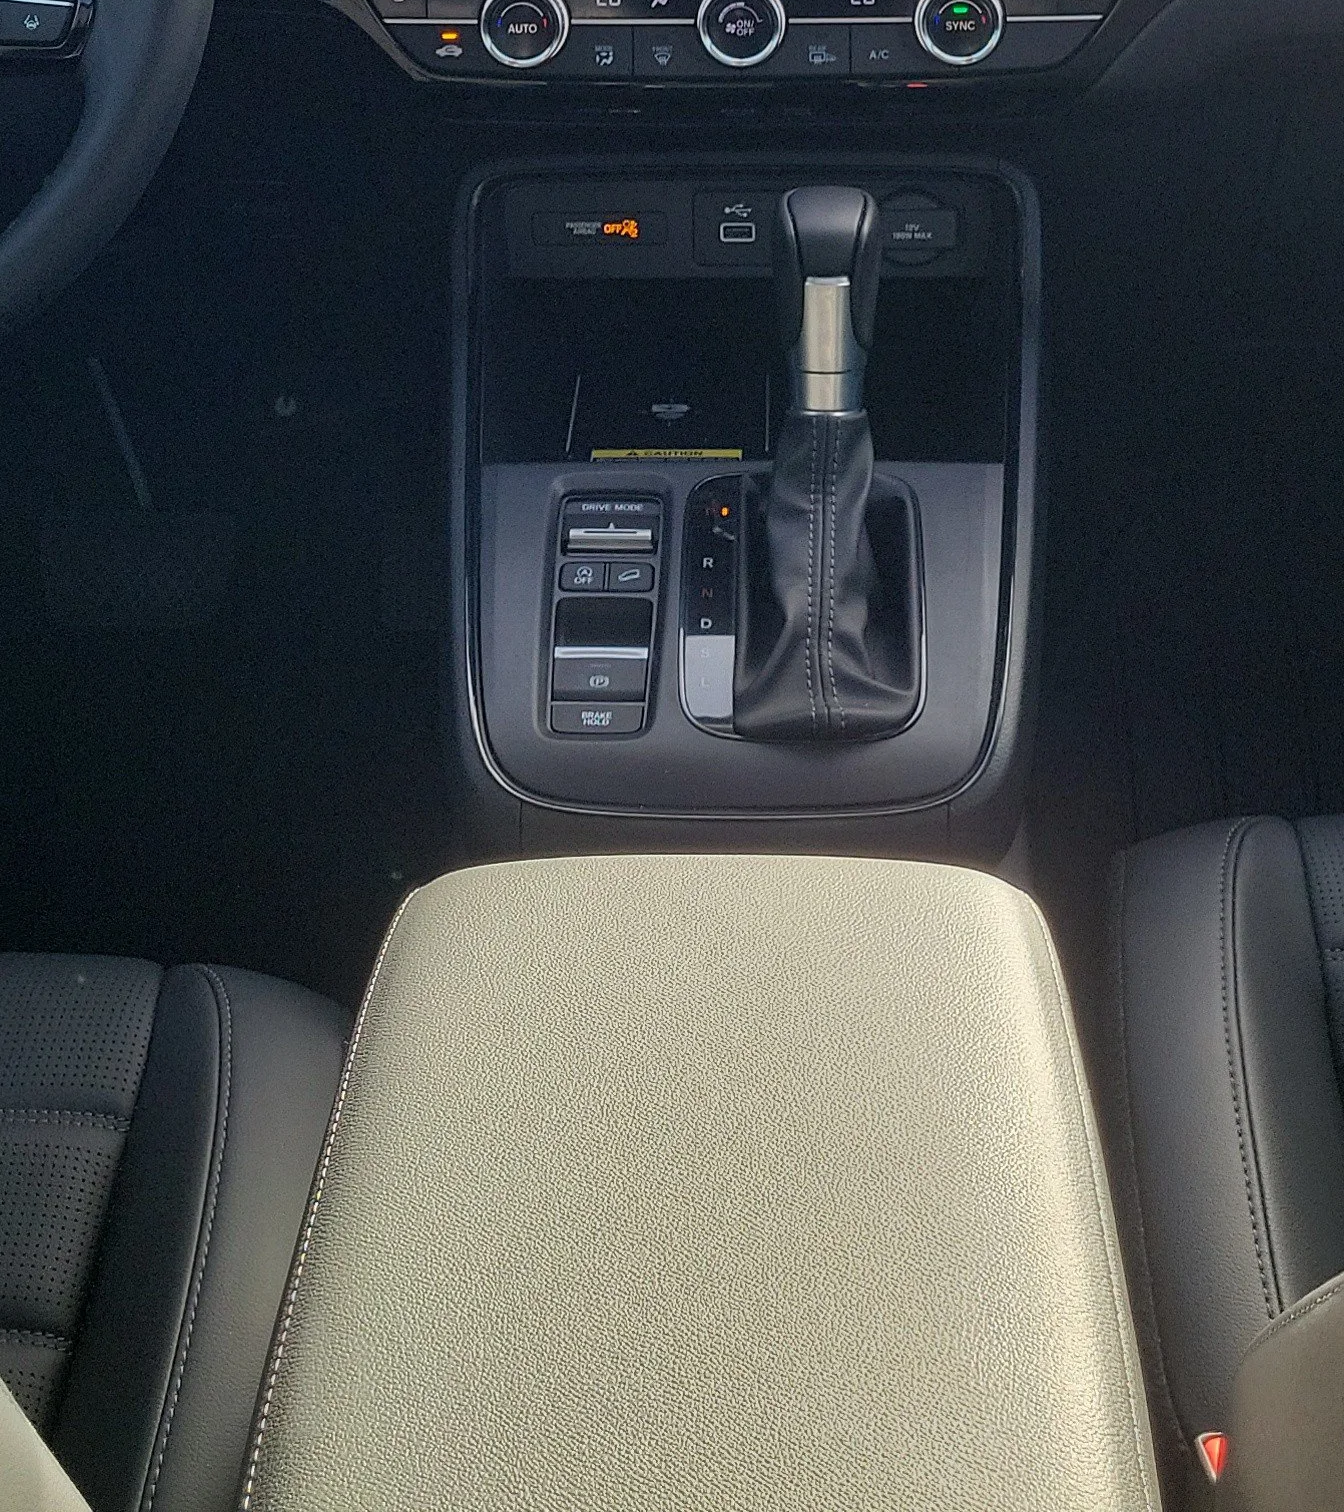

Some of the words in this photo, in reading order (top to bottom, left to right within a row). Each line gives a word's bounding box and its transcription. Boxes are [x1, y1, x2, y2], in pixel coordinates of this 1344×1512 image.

[508, 23, 537, 33] AUTO
[945, 21, 976, 31] SYNC
[736, 28, 755, 36] OFF
[869, 50, 890, 60] A/C
[581, 503, 611, 512] DRIVE
[614, 503, 644, 512] MODE
[702, 557, 714, 568] R
[574, 576, 594, 585] OFF
[700, 618, 712, 629] D
[581, 710, 612, 719] BRAKE
[582, 718, 611, 726] HOLD
